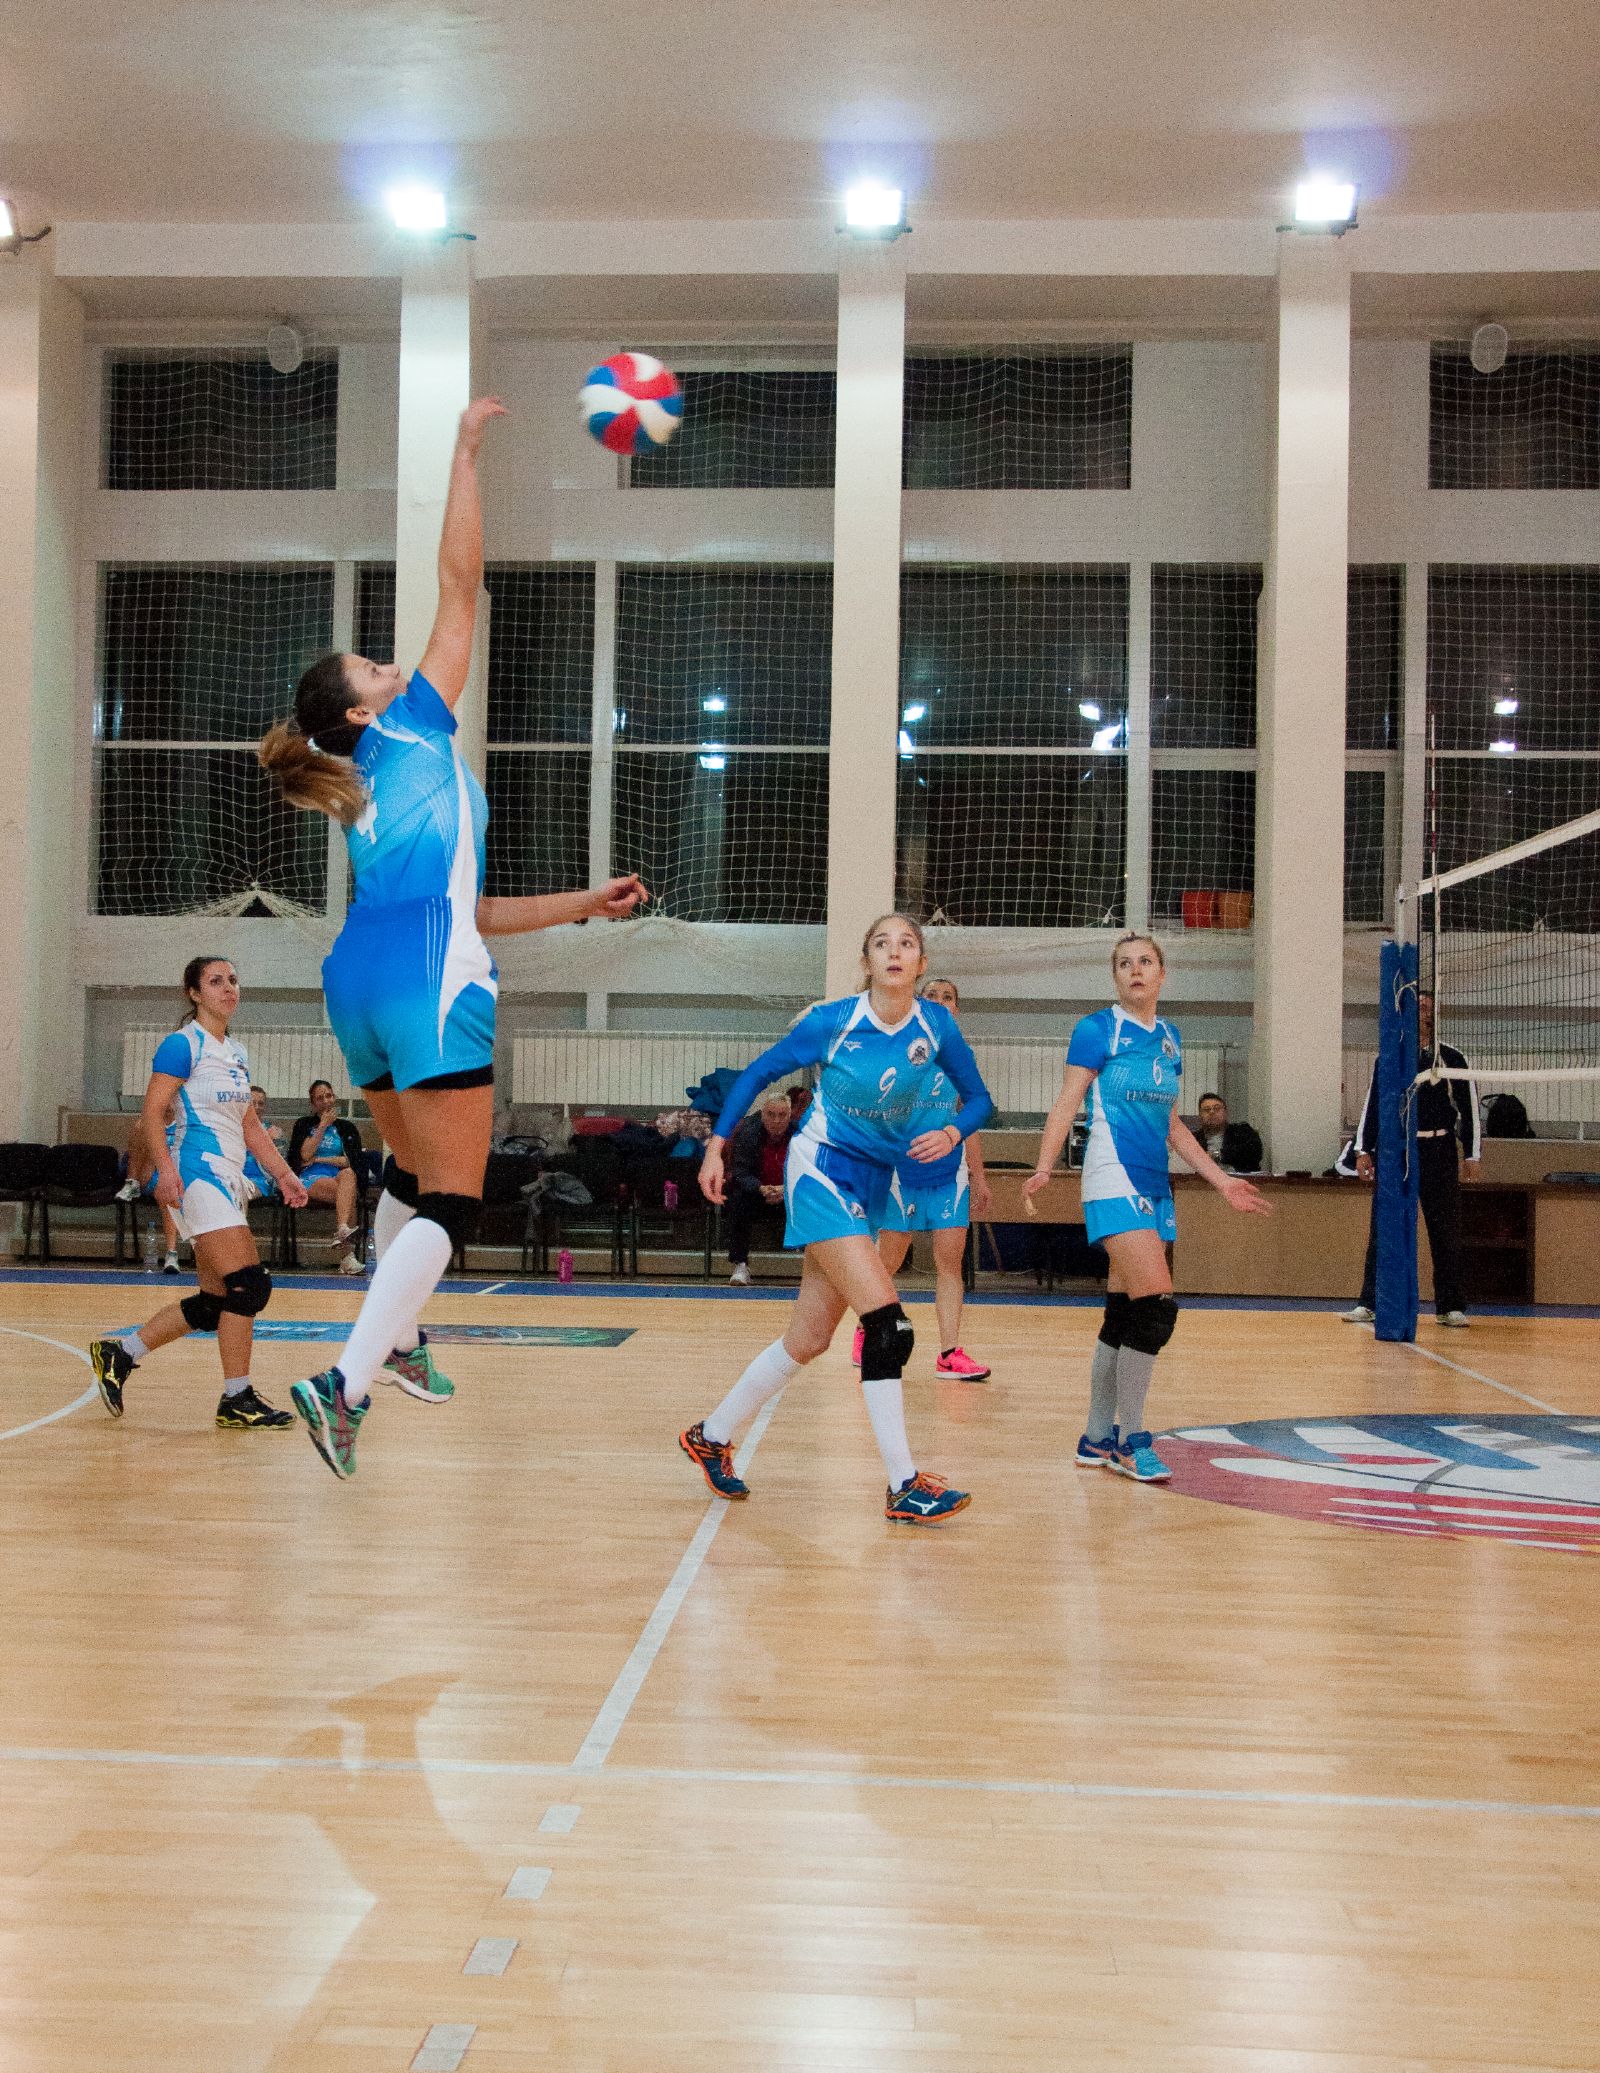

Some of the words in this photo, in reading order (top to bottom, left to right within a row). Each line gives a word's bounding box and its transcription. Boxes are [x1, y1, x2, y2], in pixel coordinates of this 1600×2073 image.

[878, 1067, 897, 1103] 9
[932, 1071, 945, 1096] 2
[1153, 1055, 1163, 1086] 6
